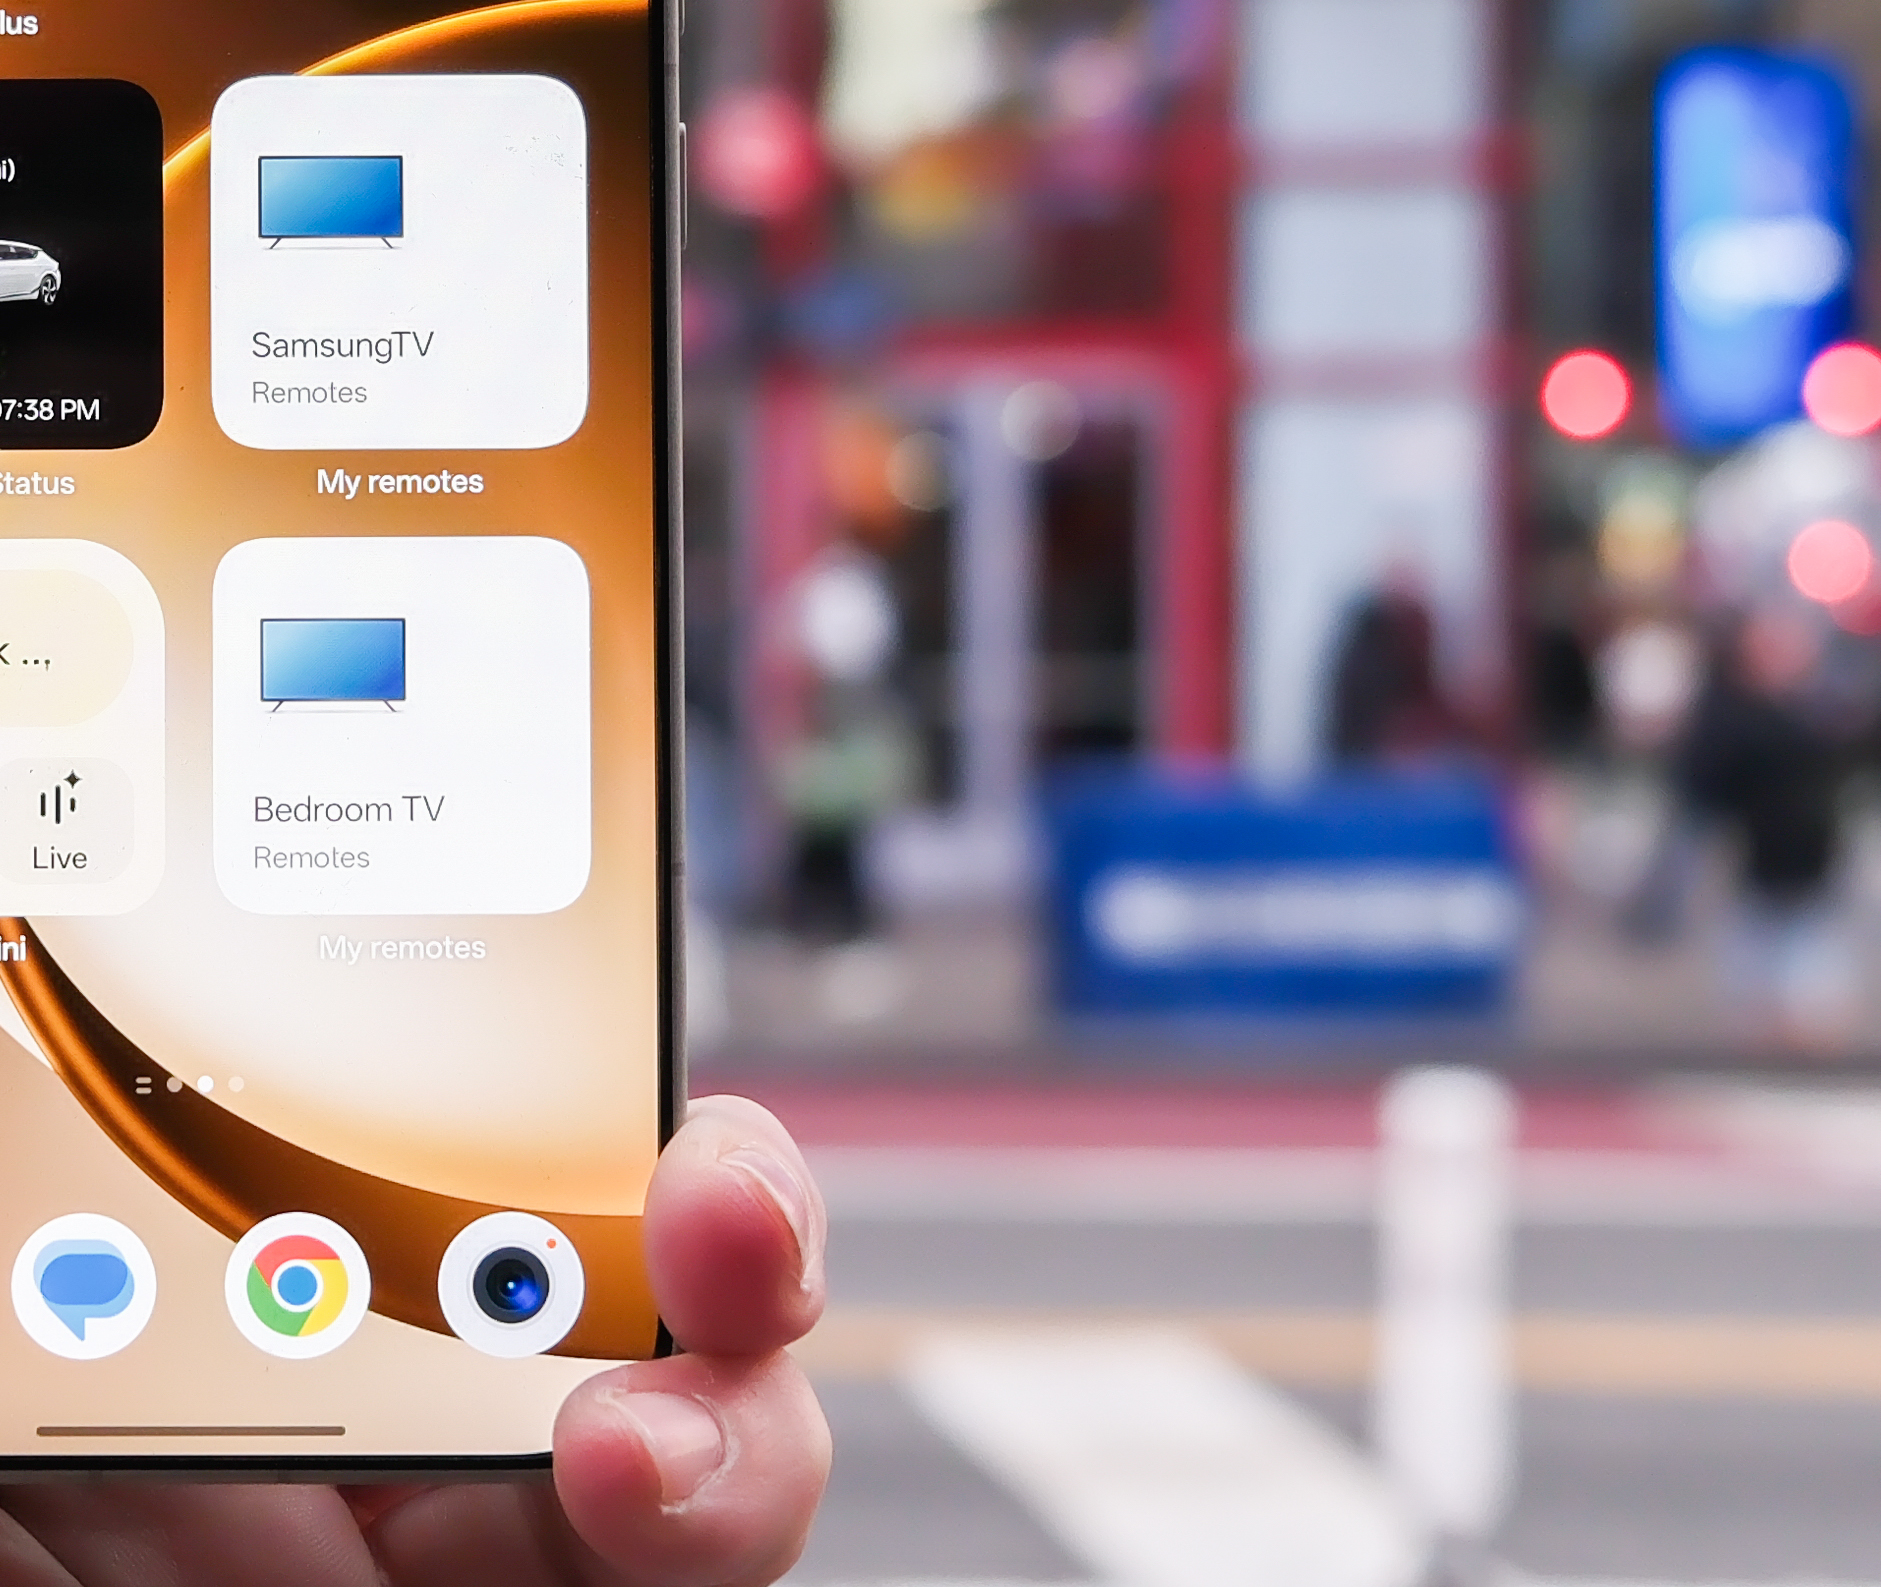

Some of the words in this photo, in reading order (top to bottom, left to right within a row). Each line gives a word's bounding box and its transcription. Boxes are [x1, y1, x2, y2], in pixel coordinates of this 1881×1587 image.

[252, 331, 435, 364] SamsungTV
[252, 381, 368, 404] Remotes
[60, 398, 100, 421] PM
[317, 469, 362, 500] My
[368, 469, 484, 494] remotes
[254, 795, 392, 823] Bedroom
[401, 795, 445, 822] TV
[33, 845, 88, 870] Live
[254, 845, 370, 869] Remotes
[319, 934, 363, 965] My
[370, 936, 486, 960] remotes
